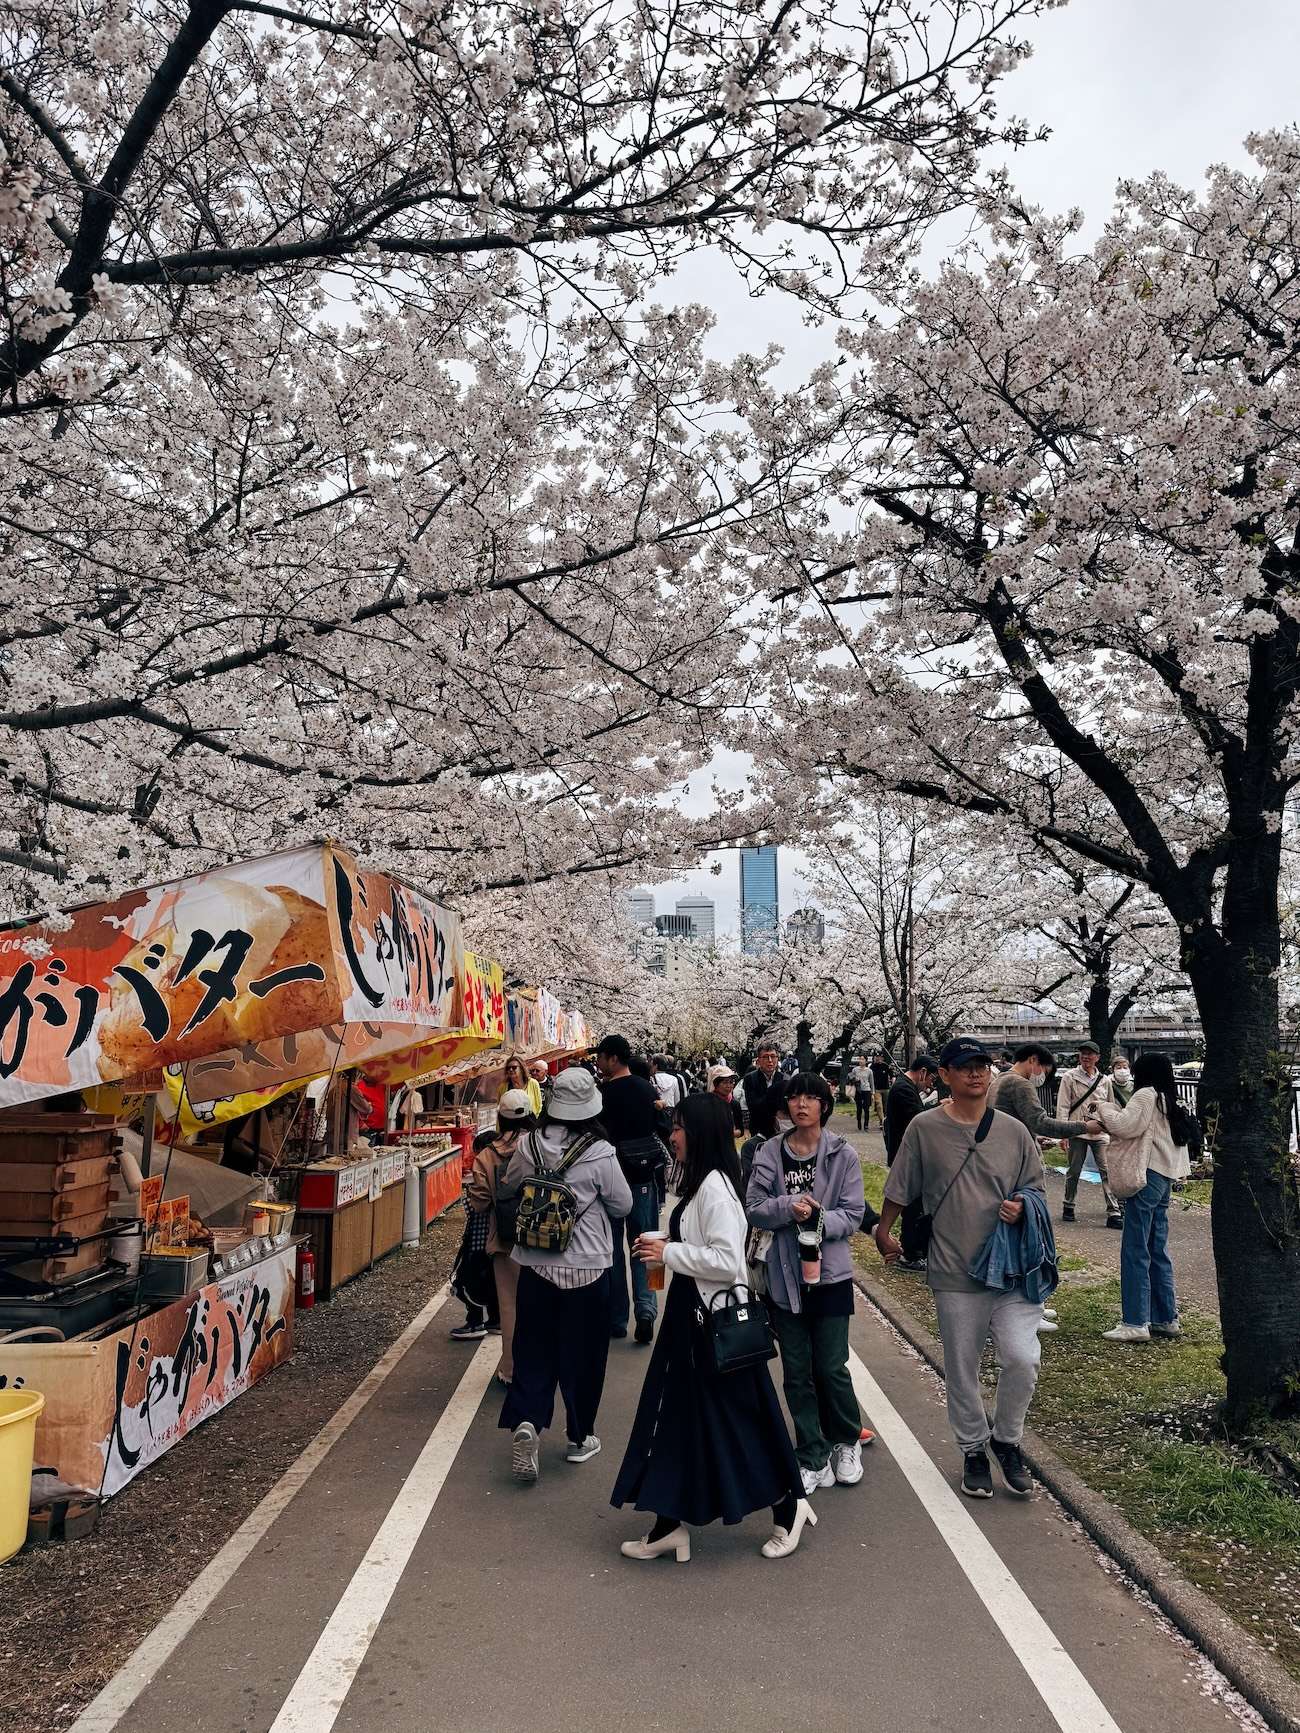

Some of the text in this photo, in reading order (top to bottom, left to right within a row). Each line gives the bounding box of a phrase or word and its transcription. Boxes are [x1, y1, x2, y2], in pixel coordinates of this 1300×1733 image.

[116, 1284, 285, 1469] じゃがバター
